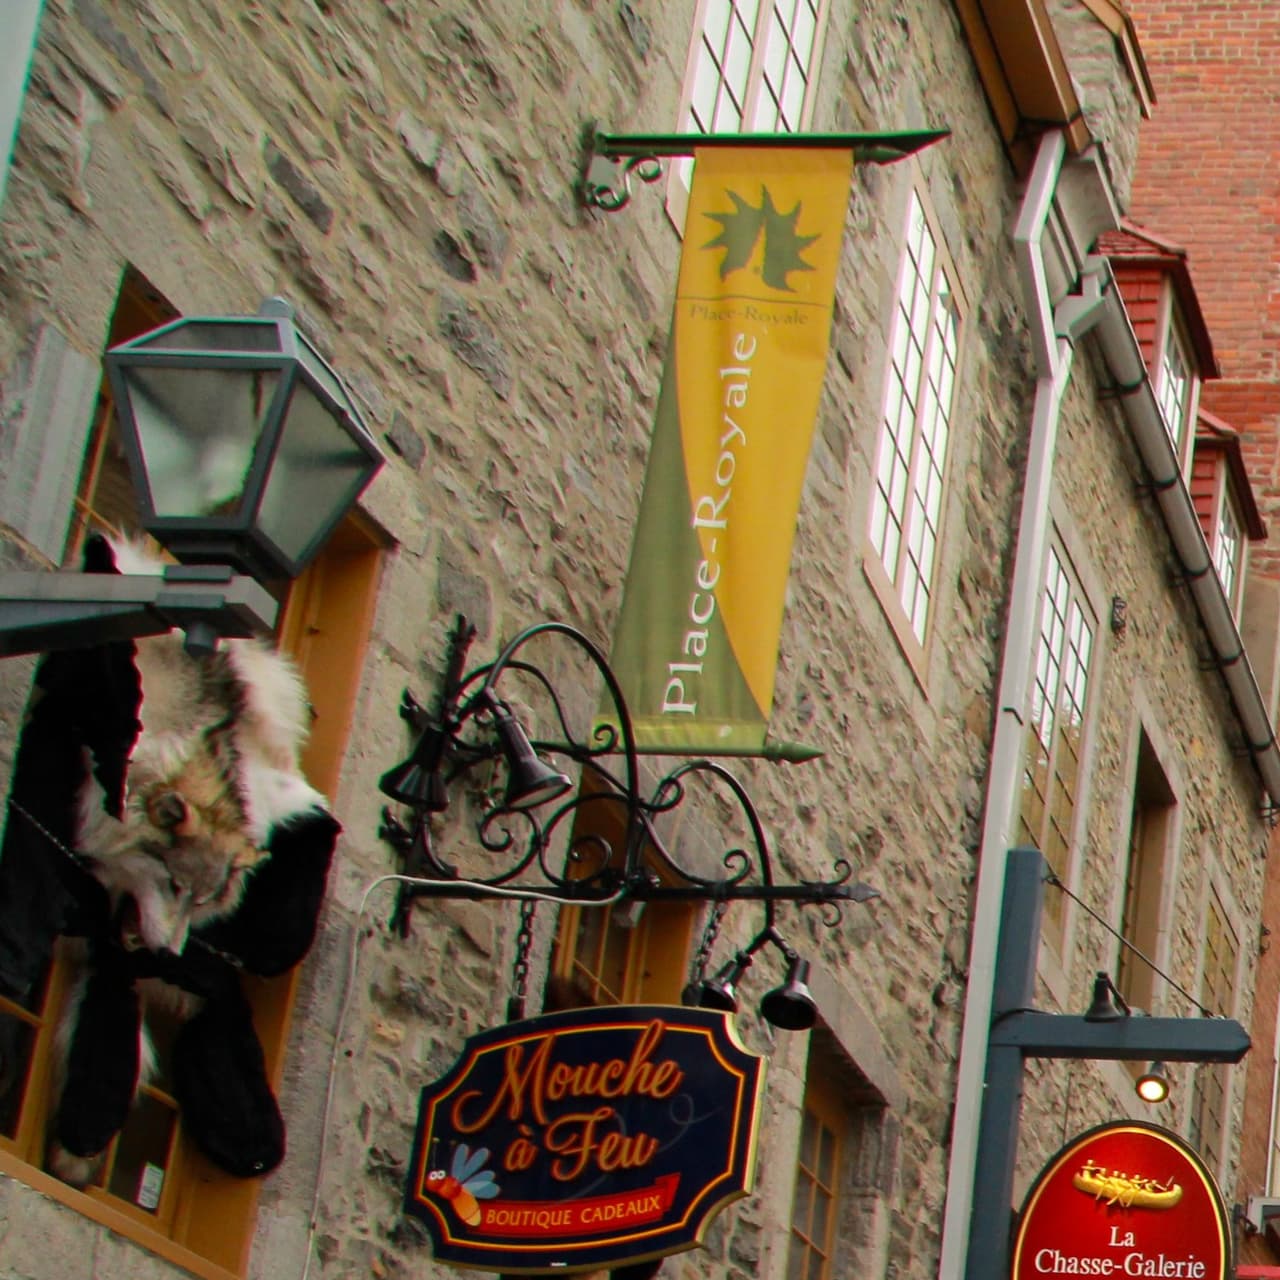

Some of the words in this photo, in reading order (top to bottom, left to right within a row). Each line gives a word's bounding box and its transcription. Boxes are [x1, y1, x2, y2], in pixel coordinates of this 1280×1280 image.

[690, 304, 809, 325] Place-Royale
[663, 332, 757, 715] Place-Royale
[450, 1019, 685, 1134] Mouche
[504, 1122, 539, 1171] à
[544, 1107, 658, 1181] Feu
[486, 1208, 571, 1228] BOUTIQUE
[581, 1194, 662, 1225] CADEAUX
[1109, 1226, 1136, 1248] La
[1034, 1249, 1206, 1280] Chasse-Galerie
